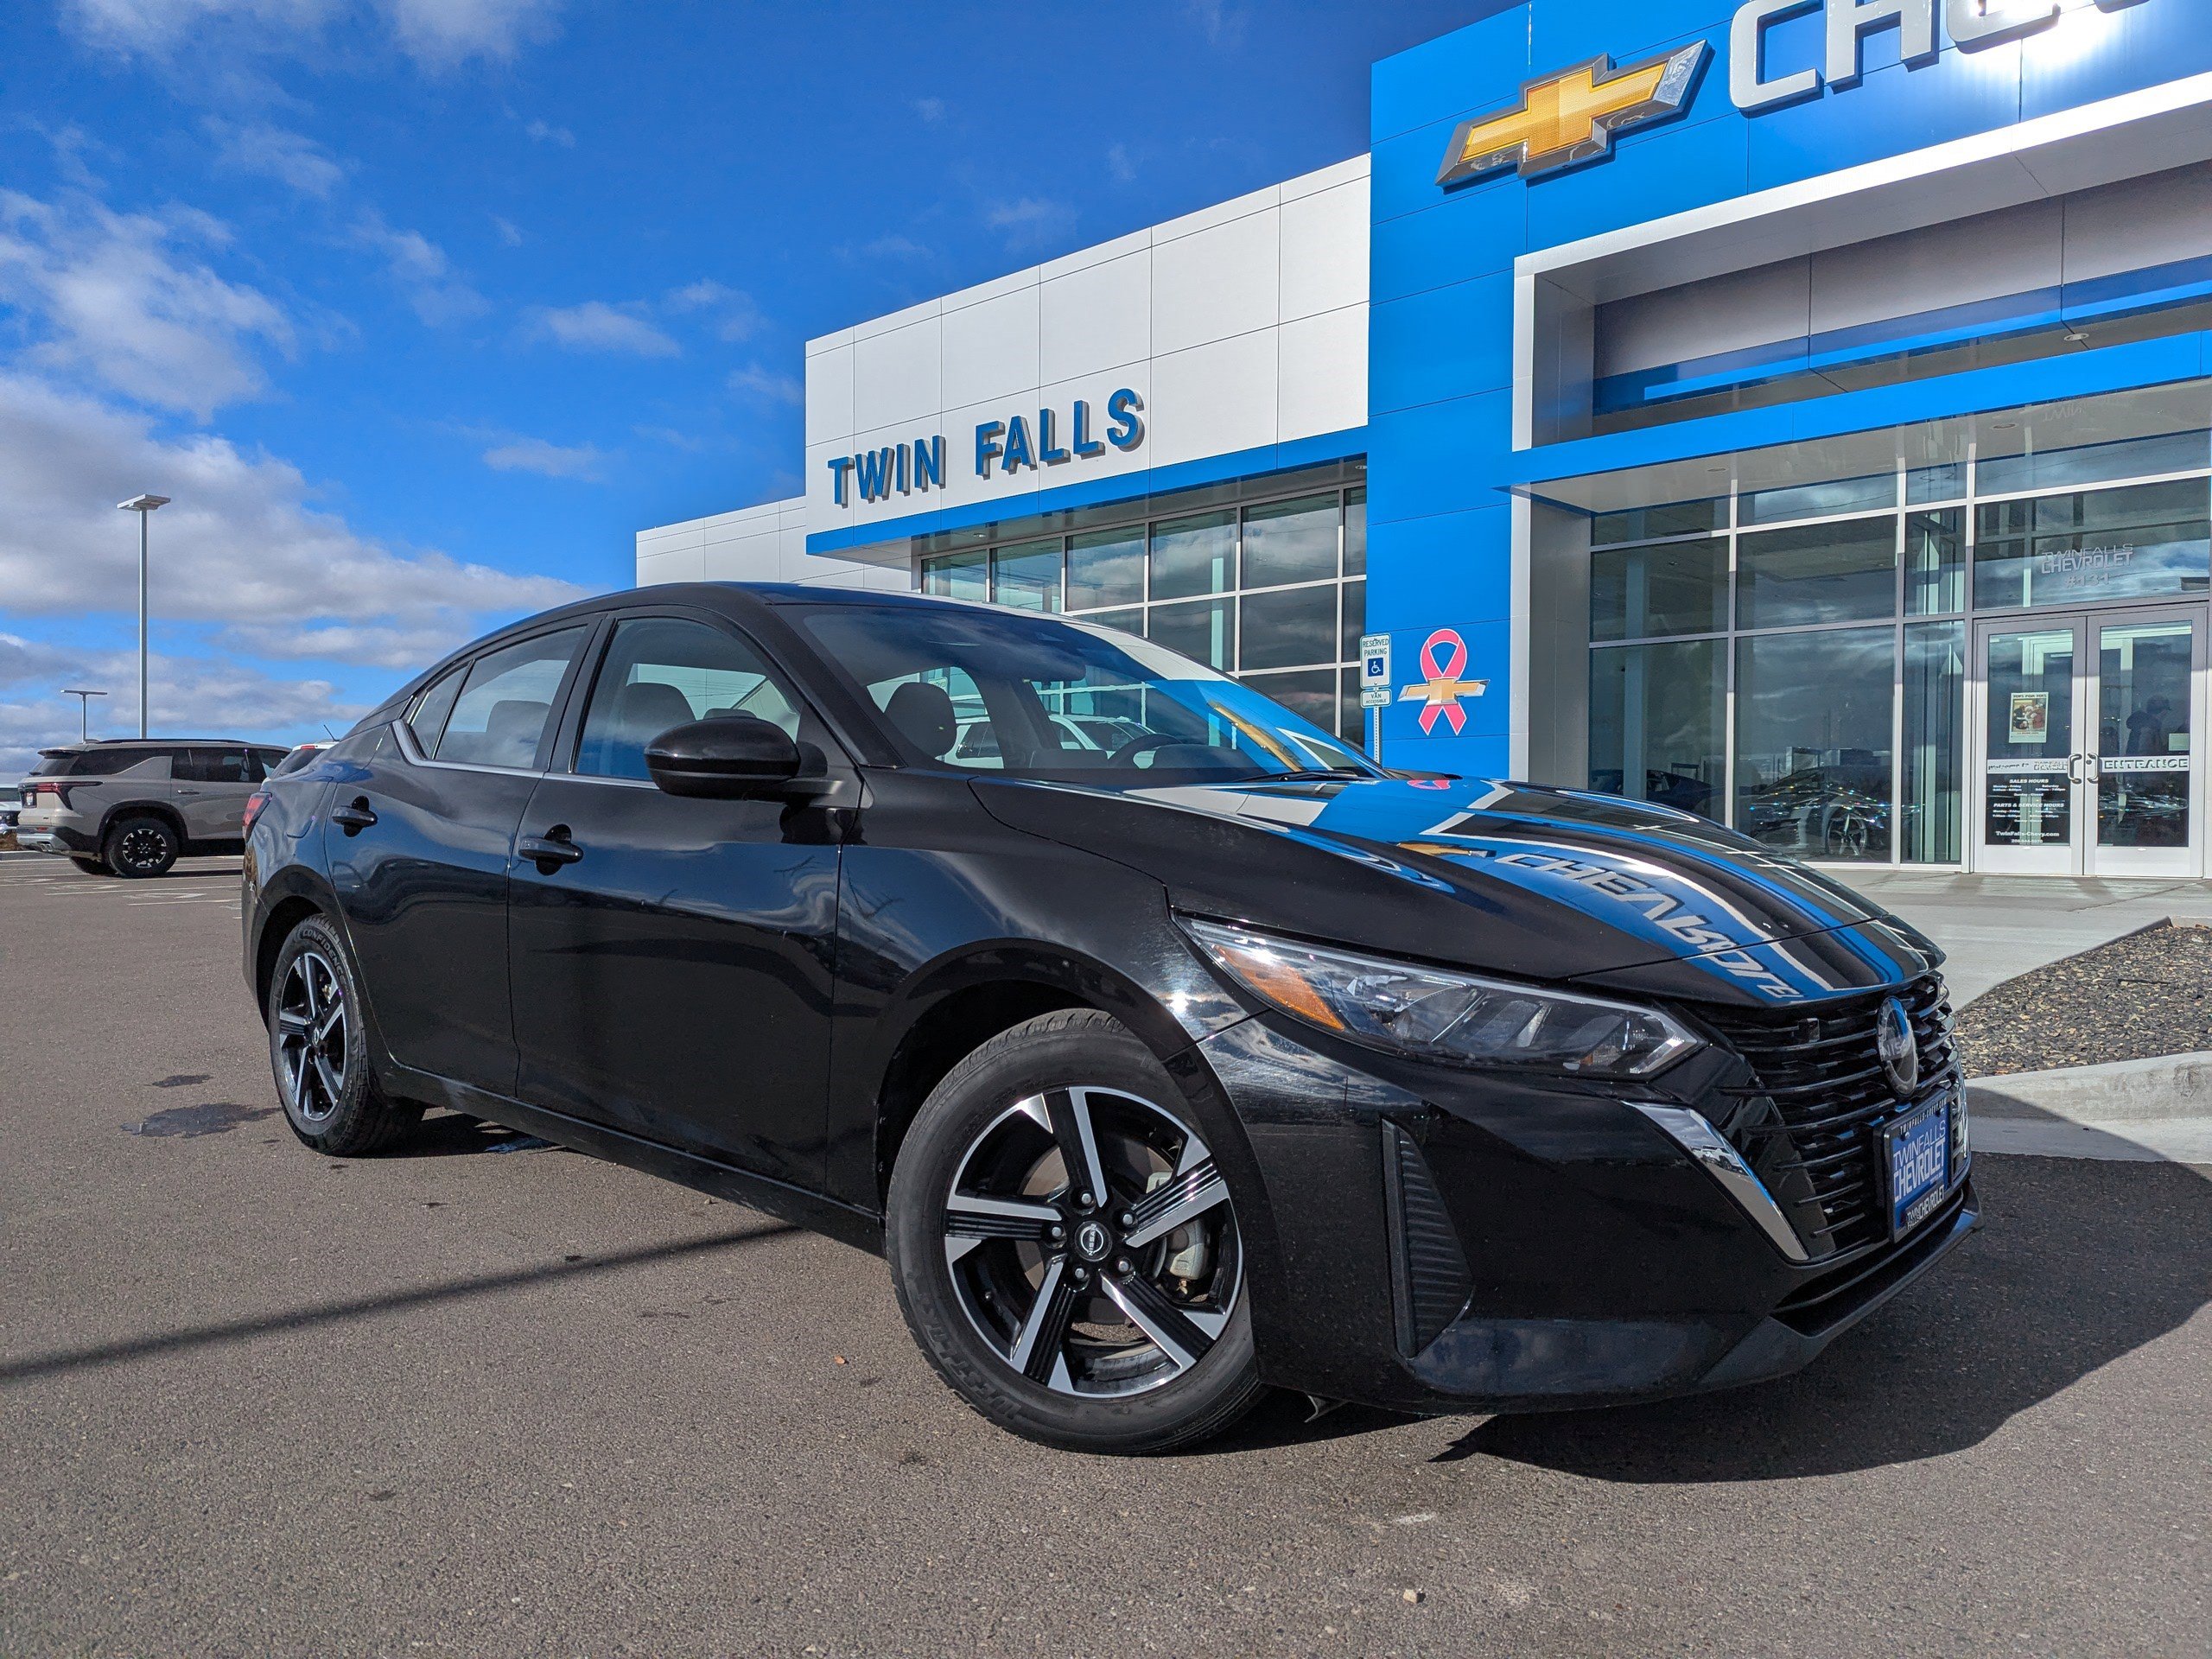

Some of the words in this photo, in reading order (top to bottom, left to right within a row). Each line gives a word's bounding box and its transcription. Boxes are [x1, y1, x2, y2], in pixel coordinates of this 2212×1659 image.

[828, 435, 945, 507] TWIN
[976, 388, 1145, 480] FALLS
[2041, 543, 2133, 561] TWINFALLS
[2041, 551, 2133, 575] CHEVROLET
[2065, 573, 2109, 588] #131
[1363, 639, 1389, 648] RESERVED
[1364, 648, 1387, 657] PARKING
[2104, 759, 2189, 769] ENTRANCE
[1893, 1120, 1946, 1171] TWINFALLS
[1893, 1137, 1946, 1204] CHEVROLET
[1918, 1185, 1945, 1220] CHEVROLET
[1088, 1223, 1097, 1256] NISSAN
